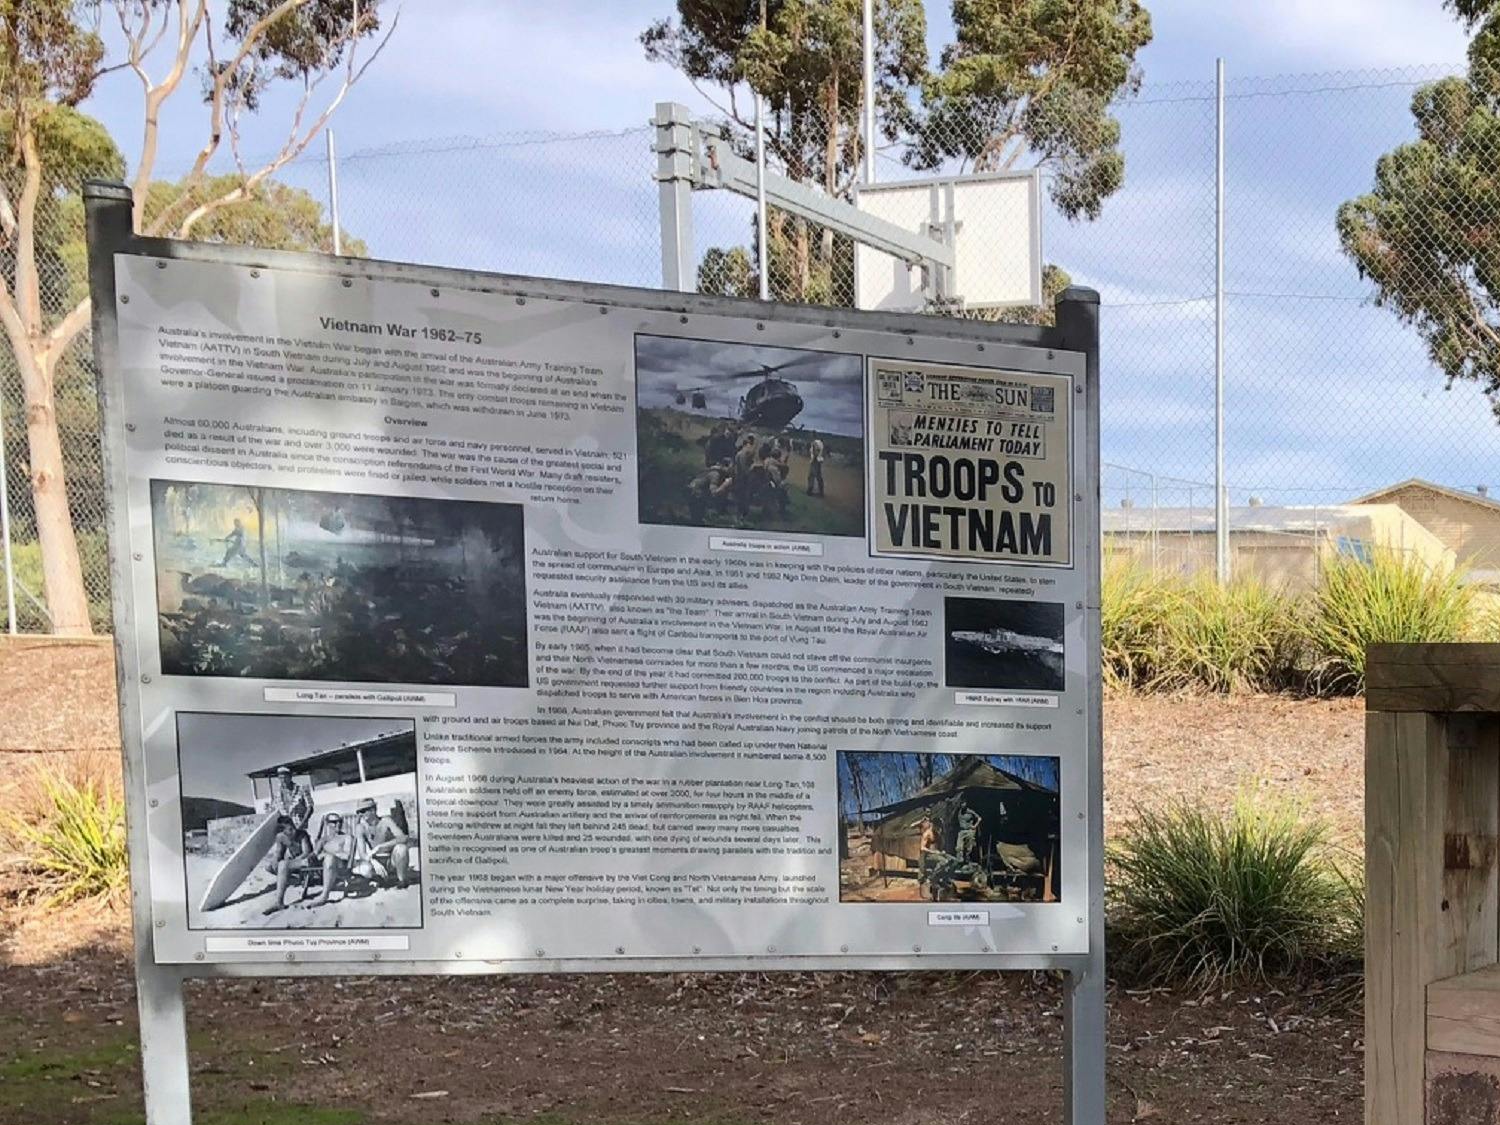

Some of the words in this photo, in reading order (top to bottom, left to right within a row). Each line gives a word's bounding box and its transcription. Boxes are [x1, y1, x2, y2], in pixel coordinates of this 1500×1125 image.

[320, 316, 382, 335] Vietnam
[387, 323, 417, 338] War
[927, 382, 961, 401] THE
[995, 387, 1028, 407] SUN
[384, 416, 428, 427] Overview
[913, 414, 978, 434] MENZIES
[986, 420, 1002, 436] TO
[1011, 423, 1040, 439] TELL
[913, 433, 994, 452] PARLIAMENT
[999, 438, 1041, 456] TODAY
[879, 451, 1025, 504] TROOPS
[1033, 482, 1056, 507] TO
[884, 503, 1051, 556] VIETNAM
